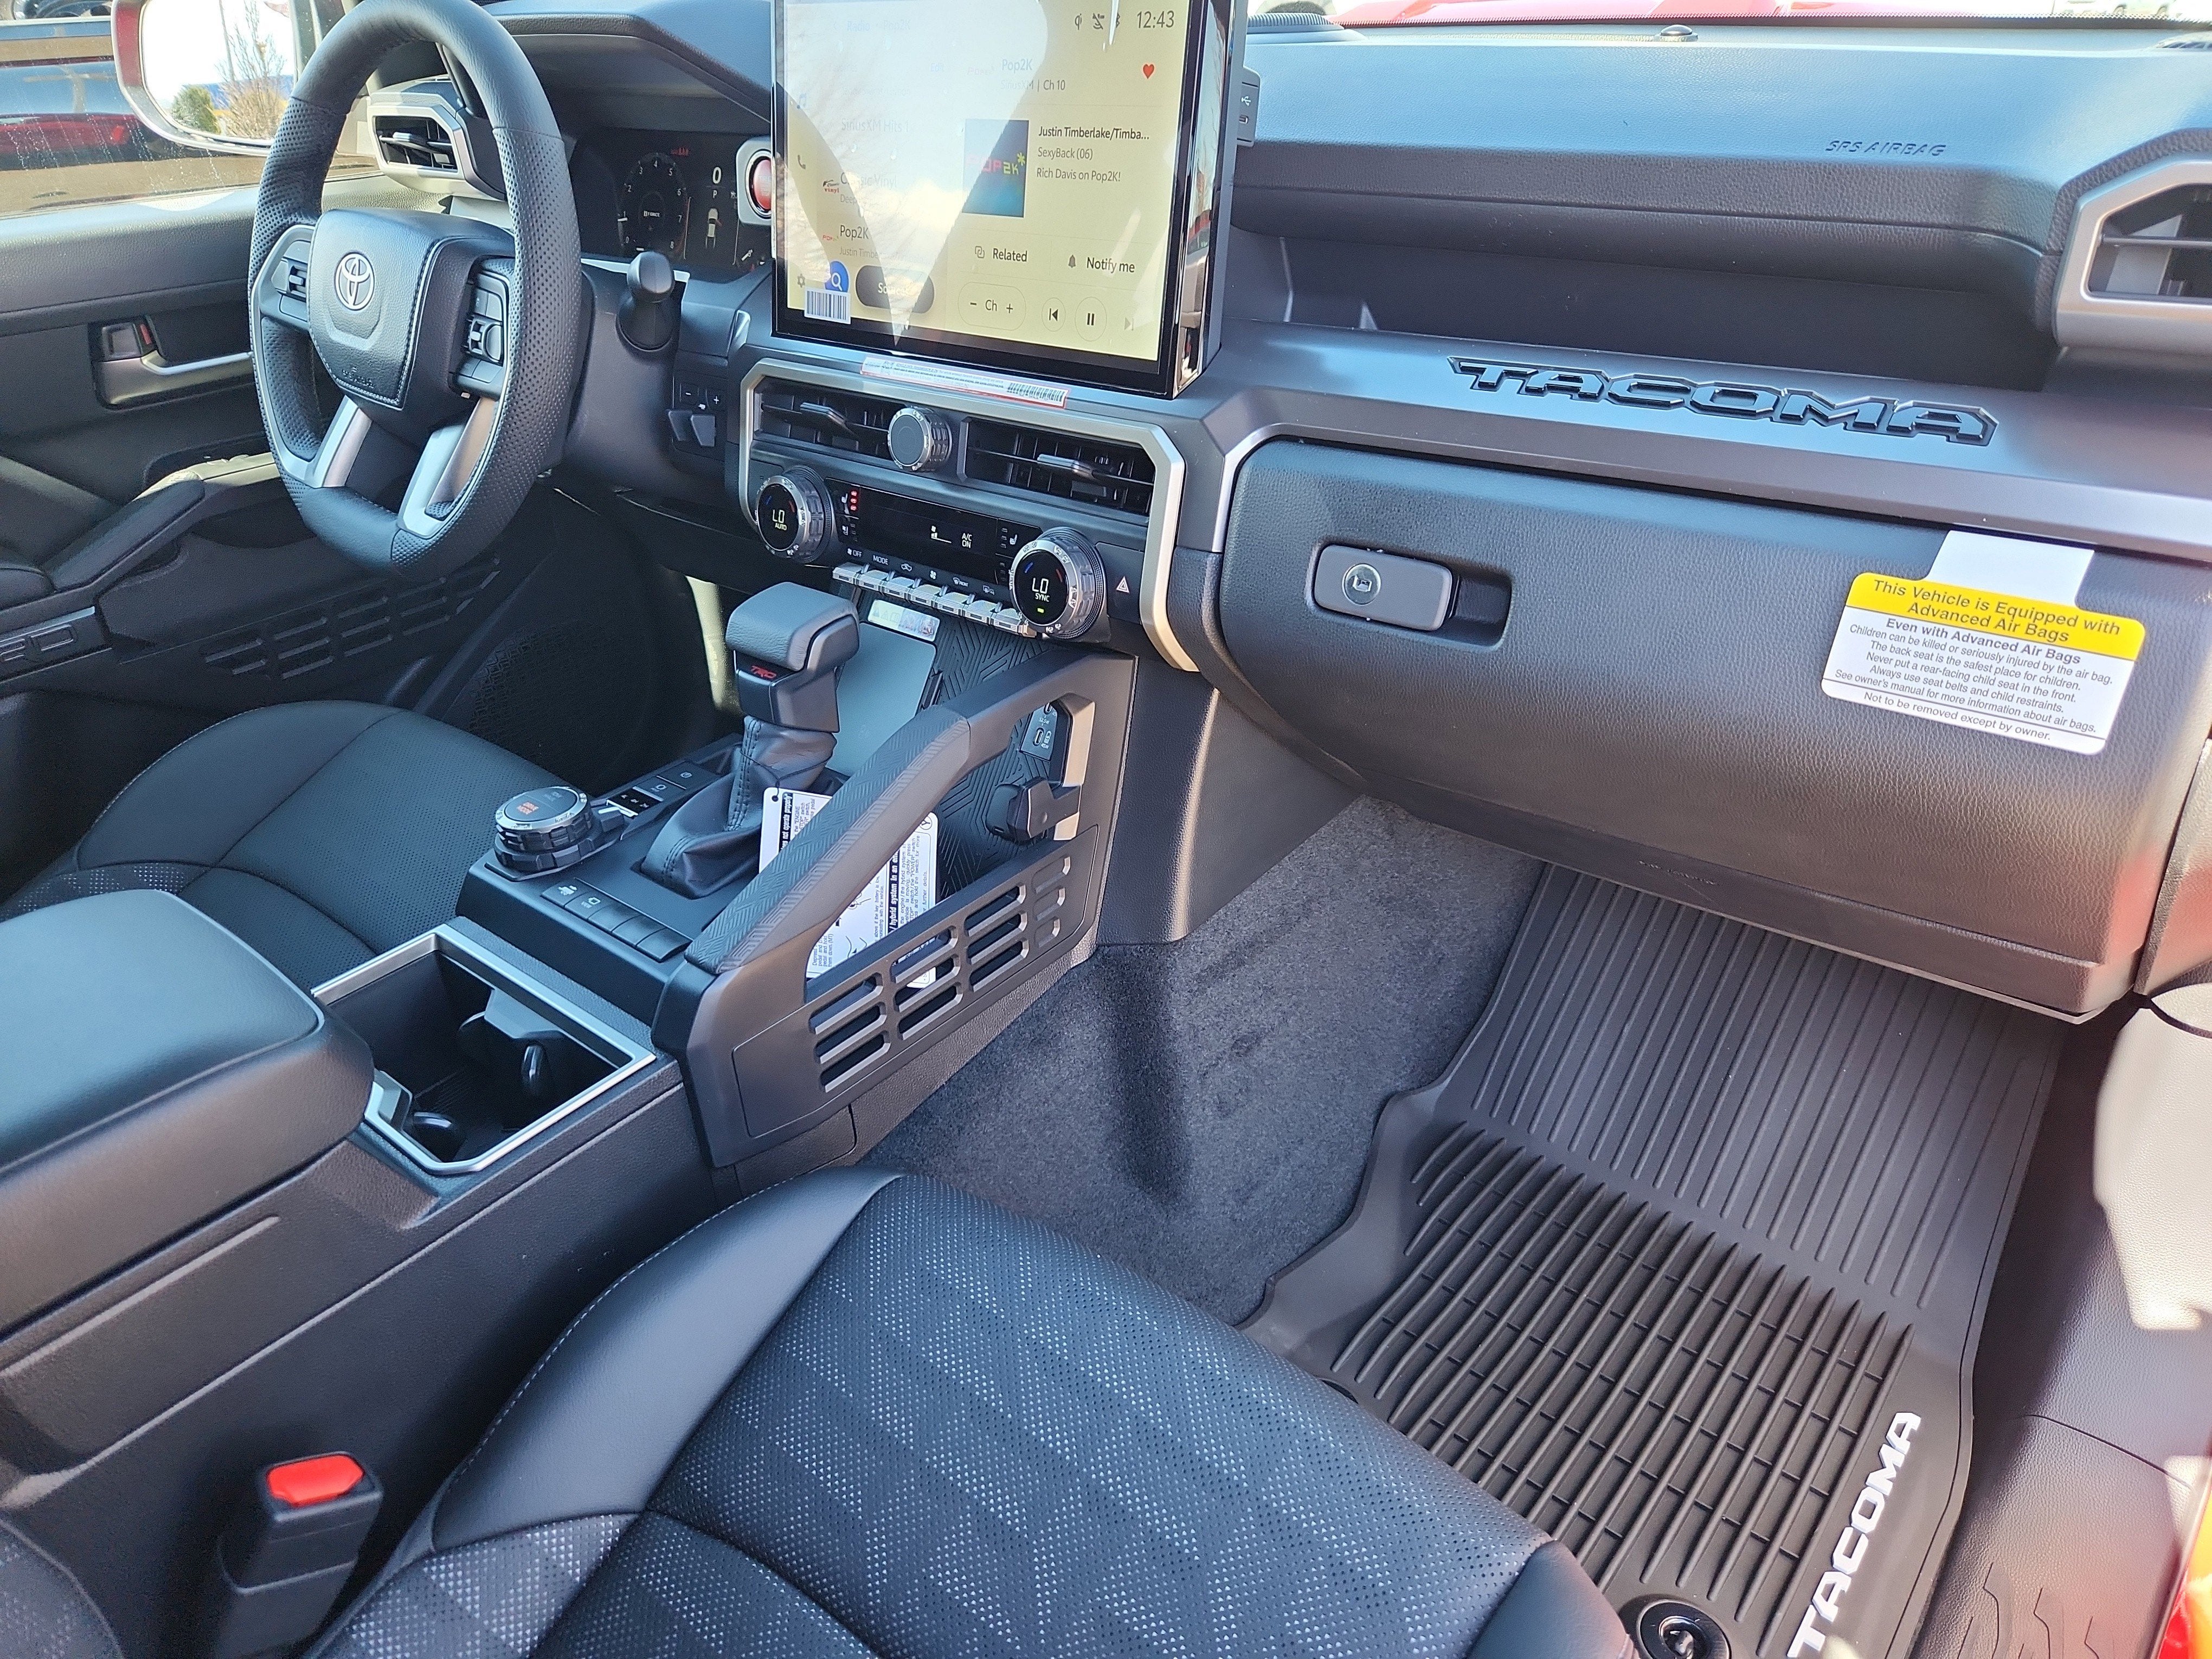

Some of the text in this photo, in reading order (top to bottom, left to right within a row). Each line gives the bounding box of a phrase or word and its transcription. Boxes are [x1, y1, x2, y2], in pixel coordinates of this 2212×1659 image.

[1136, 11, 1175, 29] 12:43
[1002, 59, 1033, 74] Pop2K
[1043, 80, 1054, 91] Ch
[1057, 80, 1066, 91] 10
[1039, 126, 1062, 139] Justin
[1038, 147, 1093, 161] SexyBack (06)
[1825, 140, 1947, 156] SRS AIRBAG
[712, 166, 722, 184] 0
[1037, 168, 1121, 185] Rich Davis on Pop2K!
[713, 190, 717, 198] P
[840, 225, 869, 240] Pop2K
[992, 248, 1028, 263] Related
[1086, 257, 1135, 274] Notify me
[985, 300, 998, 313] Ch
[1446, 356, 1999, 446] TACOMA
[962, 533, 973, 542] A/C
[962, 540, 972, 549] ON
[852, 549, 863, 558] OFF
[873, 555, 889, 565] MODE
[1035, 593, 1050, 602] SYNC
[1874, 580, 2120, 635] This Vehicle is Equipped with
[1907, 602, 2069, 643] Advanced Air Bags
[1886, 618, 2081, 665] Even with Advanced Air Bags
[1849, 624, 2112, 685] Children can be killed or seriously injured by the air bag.
[1870, 640, 2080, 691] The back seat is the safest place for children.
[1866, 651, 2076, 703] Never put a rear-facing child seat in the front.
[1869, 665, 2063, 713] Always use seat belts and child restraints.
[1835, 669, 2096, 732] See owner's manual for more information about air bags.
[1864, 691, 2050, 740] Not to be removed except by owner.
[889, 907, 897, 925] hybrid
[1786, 1412, 1921, 1658] TACOMA
